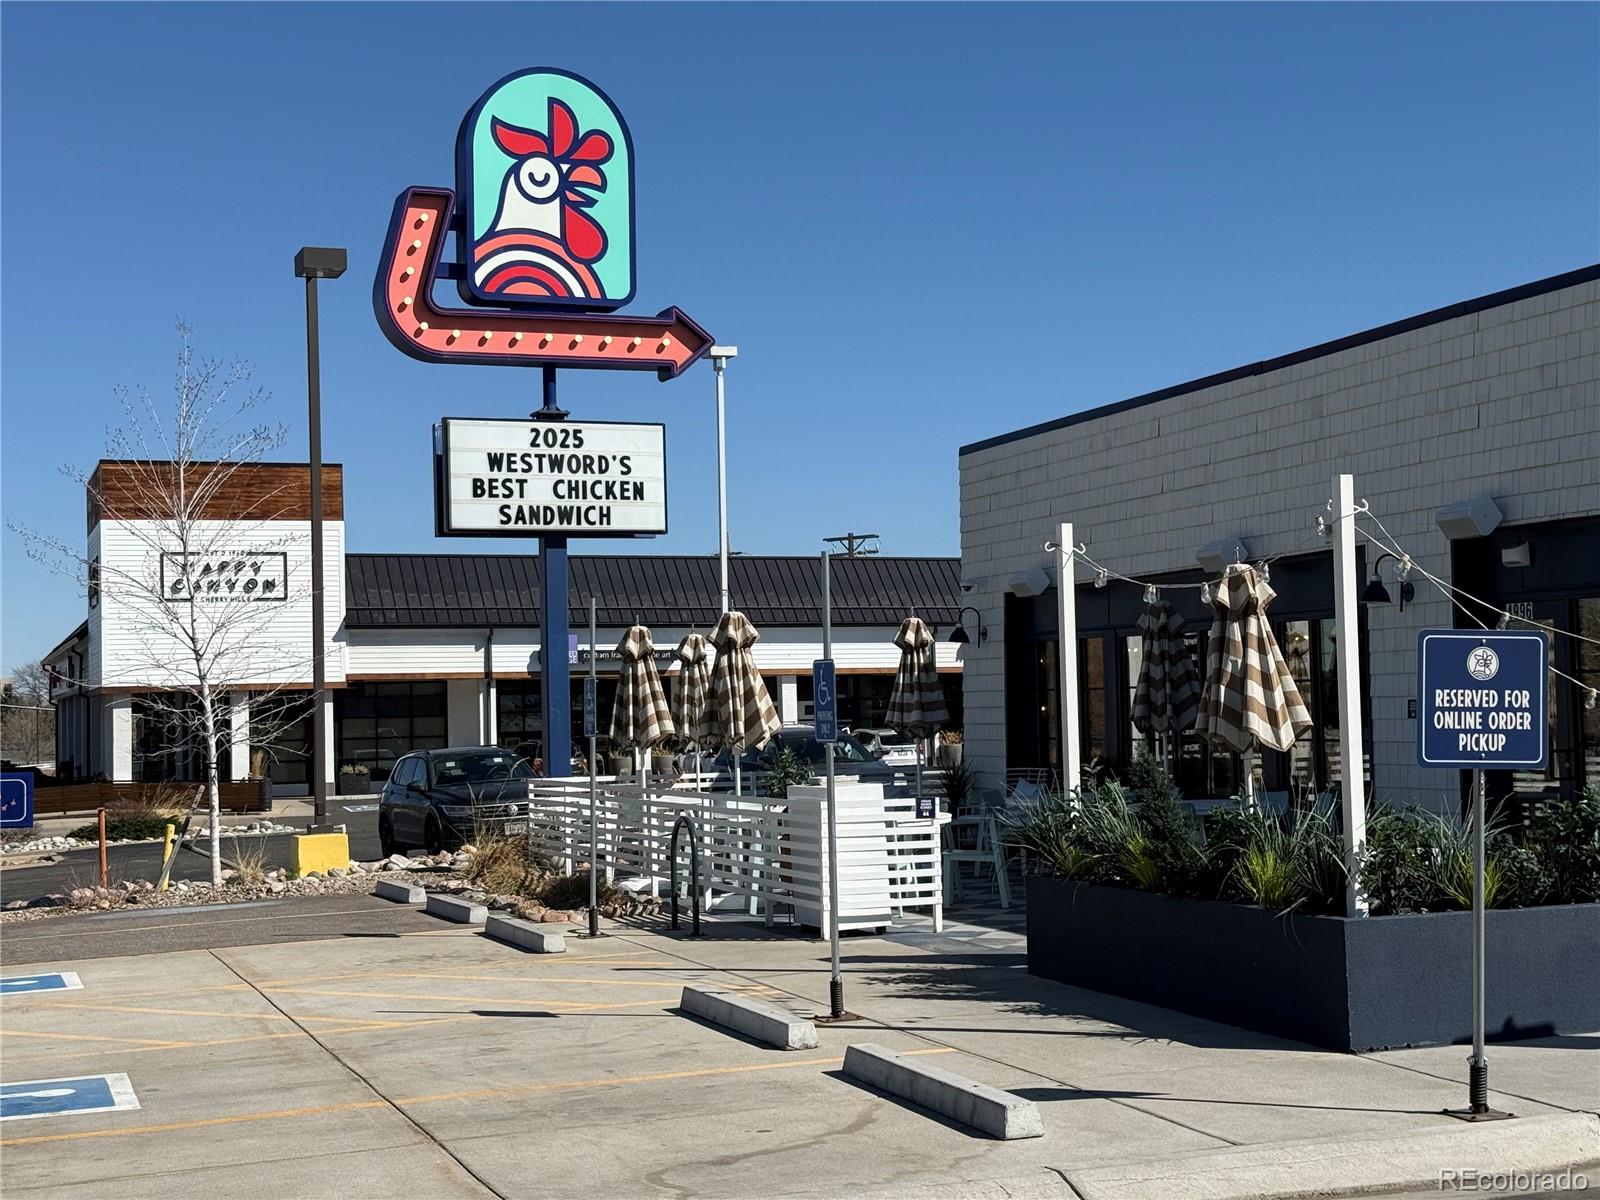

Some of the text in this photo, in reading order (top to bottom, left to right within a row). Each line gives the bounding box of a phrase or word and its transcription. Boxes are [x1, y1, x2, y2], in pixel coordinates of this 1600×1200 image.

[530, 427, 584, 449] 2025
[487, 452, 632, 476] WESTWORD'S
[472, 477, 645, 501] BEST CHICKEN
[499, 504, 611, 526] SANDWICH
[1435, 688, 1530, 709] RESERVED FOR
[1433, 710, 1532, 730] ONLINE ORDER
[1458, 733, 1507, 752] PICKUP
